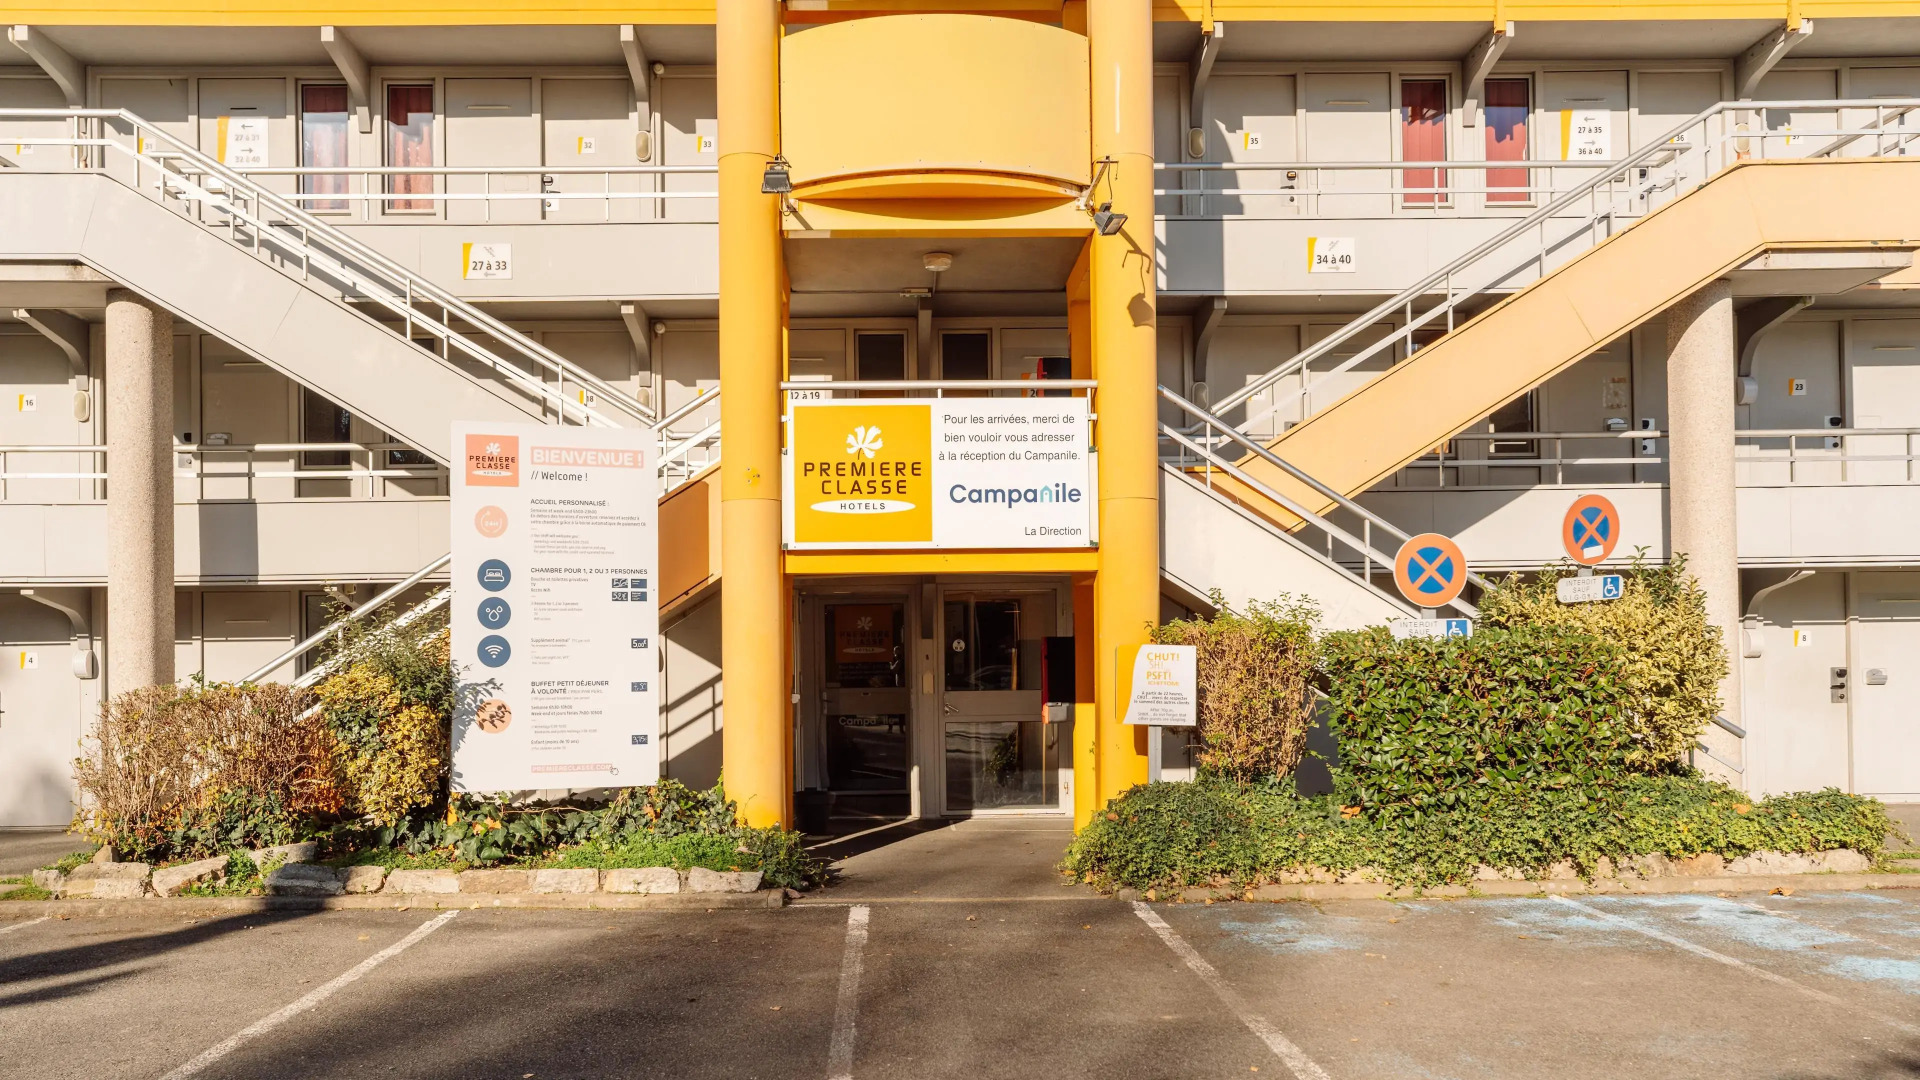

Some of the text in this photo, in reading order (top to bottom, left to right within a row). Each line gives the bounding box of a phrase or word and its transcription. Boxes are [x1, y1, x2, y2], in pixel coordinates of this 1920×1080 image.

[1578, 126, 1586, 134] 27
[1594, 126, 1602, 134] 35
[1251, 137, 1259, 145] 35
[1676, 134, 1684, 142] 36
[145, 142, 153, 150] 31
[584, 141, 593, 149] 32
[1317, 254, 1351, 264] 34 à 40
[472, 260, 507, 271] 27 à 33
[1795, 383, 1804, 391] 23
[791, 390, 820, 400] 12 à 19
[25, 399, 34, 407] 16
[944, 413, 1075, 426] Pour les arrivées, merci de
[944, 433, 1075, 442] bien vouloir vous adresser
[469, 455, 516, 464] PREMIERE
[533, 449, 634, 466] BIENVENUE
[939, 450, 1080, 462] à la réception du Campanile.
[476, 462, 510, 470] CLASSE
[803, 462, 922, 477] PREMIERE
[541, 471, 583, 481] Welcome
[821, 480, 907, 495] CLASSE
[949, 482, 1082, 509] Campanile
[559, 499, 606, 507] PERSONNALISÉ
[840, 502, 886, 510] HOTELS
[1024, 526, 1082, 536] La Direction
[1566, 578, 1597, 587] INTERDIT
[1146, 652, 1180, 661] CHUT!
